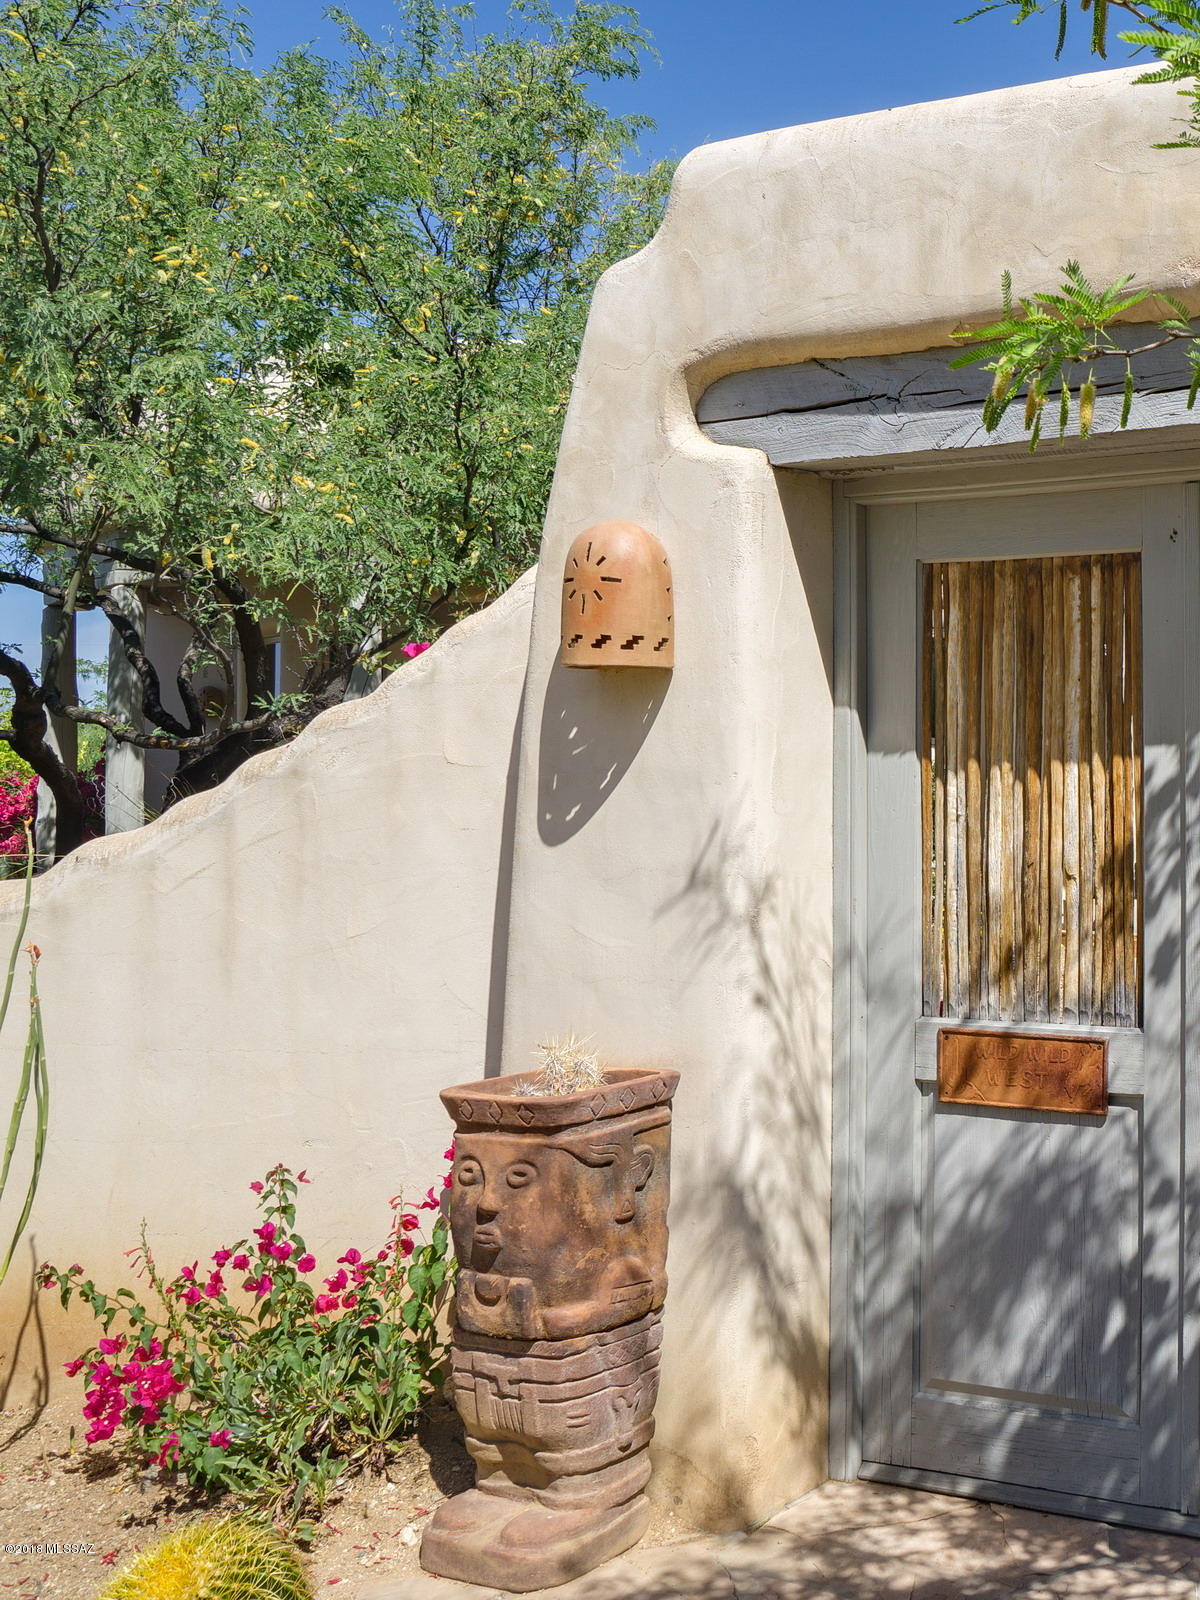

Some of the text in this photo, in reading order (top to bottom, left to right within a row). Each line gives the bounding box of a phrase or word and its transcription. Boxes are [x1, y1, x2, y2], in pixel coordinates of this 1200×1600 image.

[975, 1043, 1072, 1064] WILD WILD
[985, 1069, 1050, 1090] WEST
